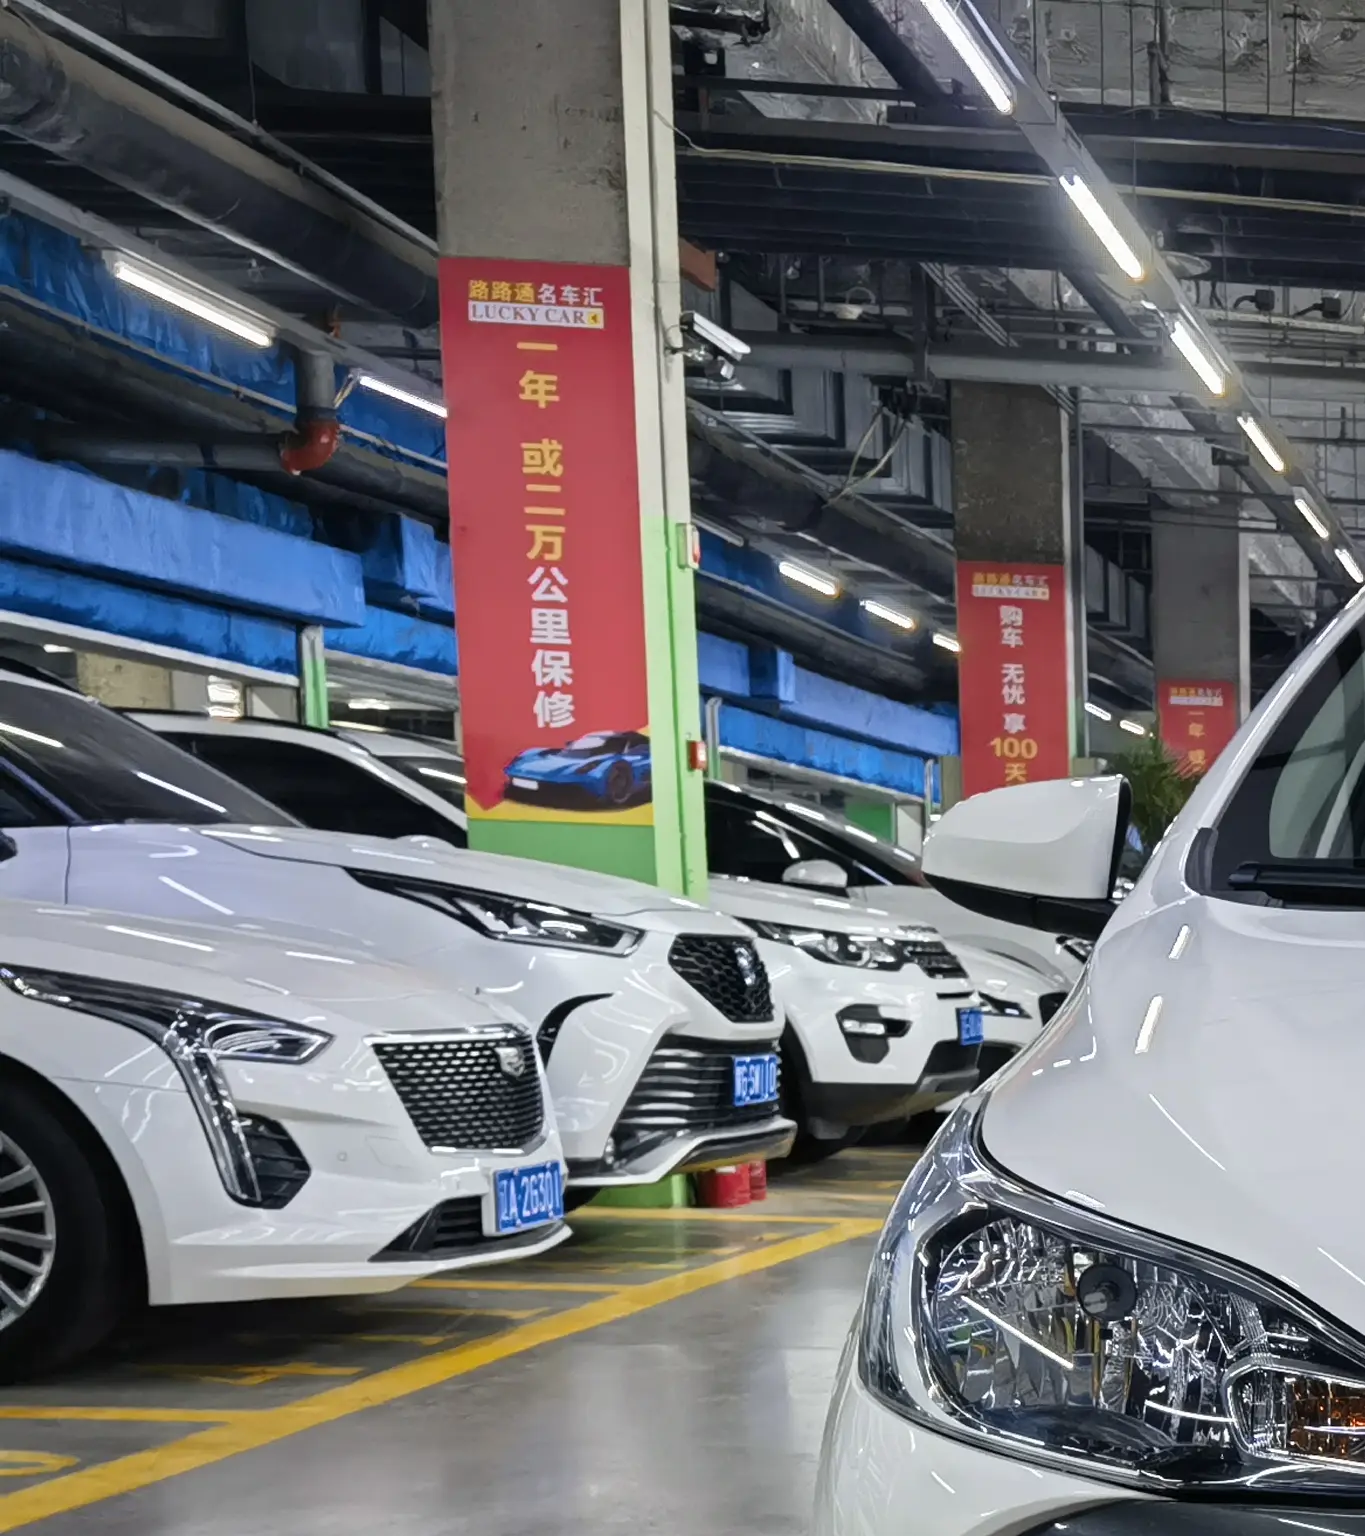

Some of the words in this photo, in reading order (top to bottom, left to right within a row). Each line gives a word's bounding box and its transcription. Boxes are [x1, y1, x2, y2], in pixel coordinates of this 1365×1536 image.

[469, 280, 604, 306] 路路通名车汇
[471, 304, 540, 322] LUCKY
[545, 308, 587, 325] CAR
